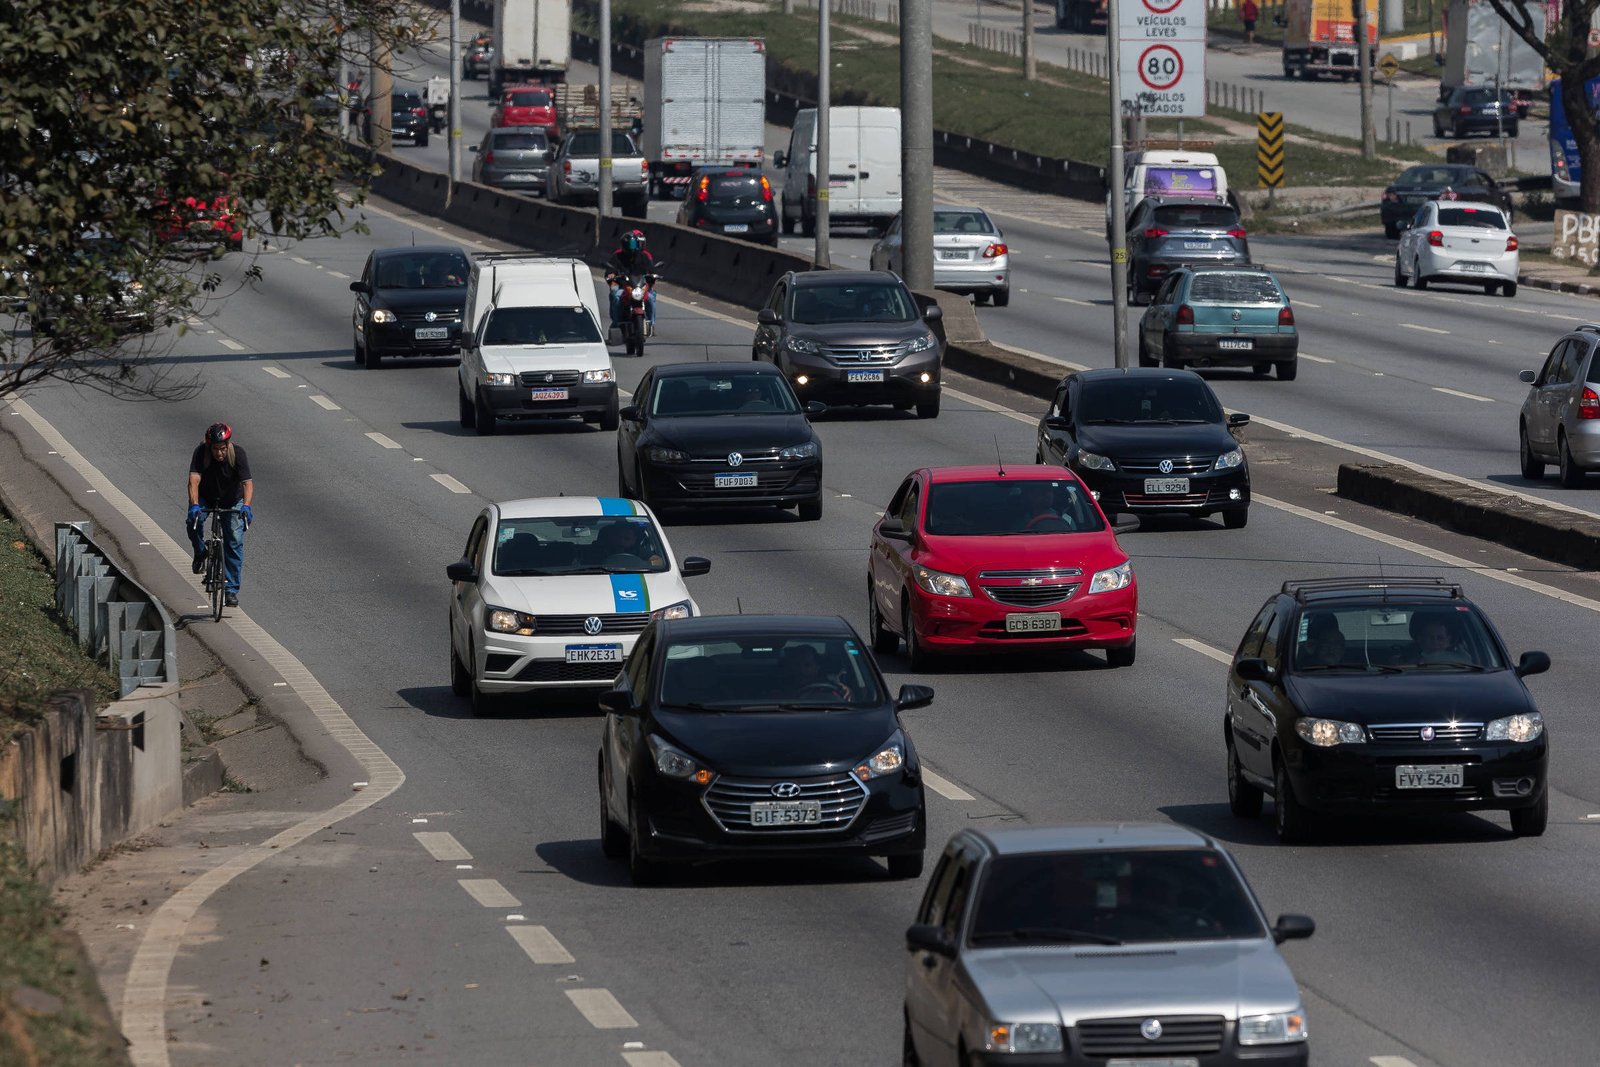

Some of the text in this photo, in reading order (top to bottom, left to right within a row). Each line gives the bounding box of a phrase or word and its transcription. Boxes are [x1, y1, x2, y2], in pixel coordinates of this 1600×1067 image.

[1137, 15, 1187, 26] VEÍCULOS
[1146, 28, 1177, 38] LEVES
[1148, 57, 1175, 75] 80
[570, 650, 617, 661] EHK2E31
